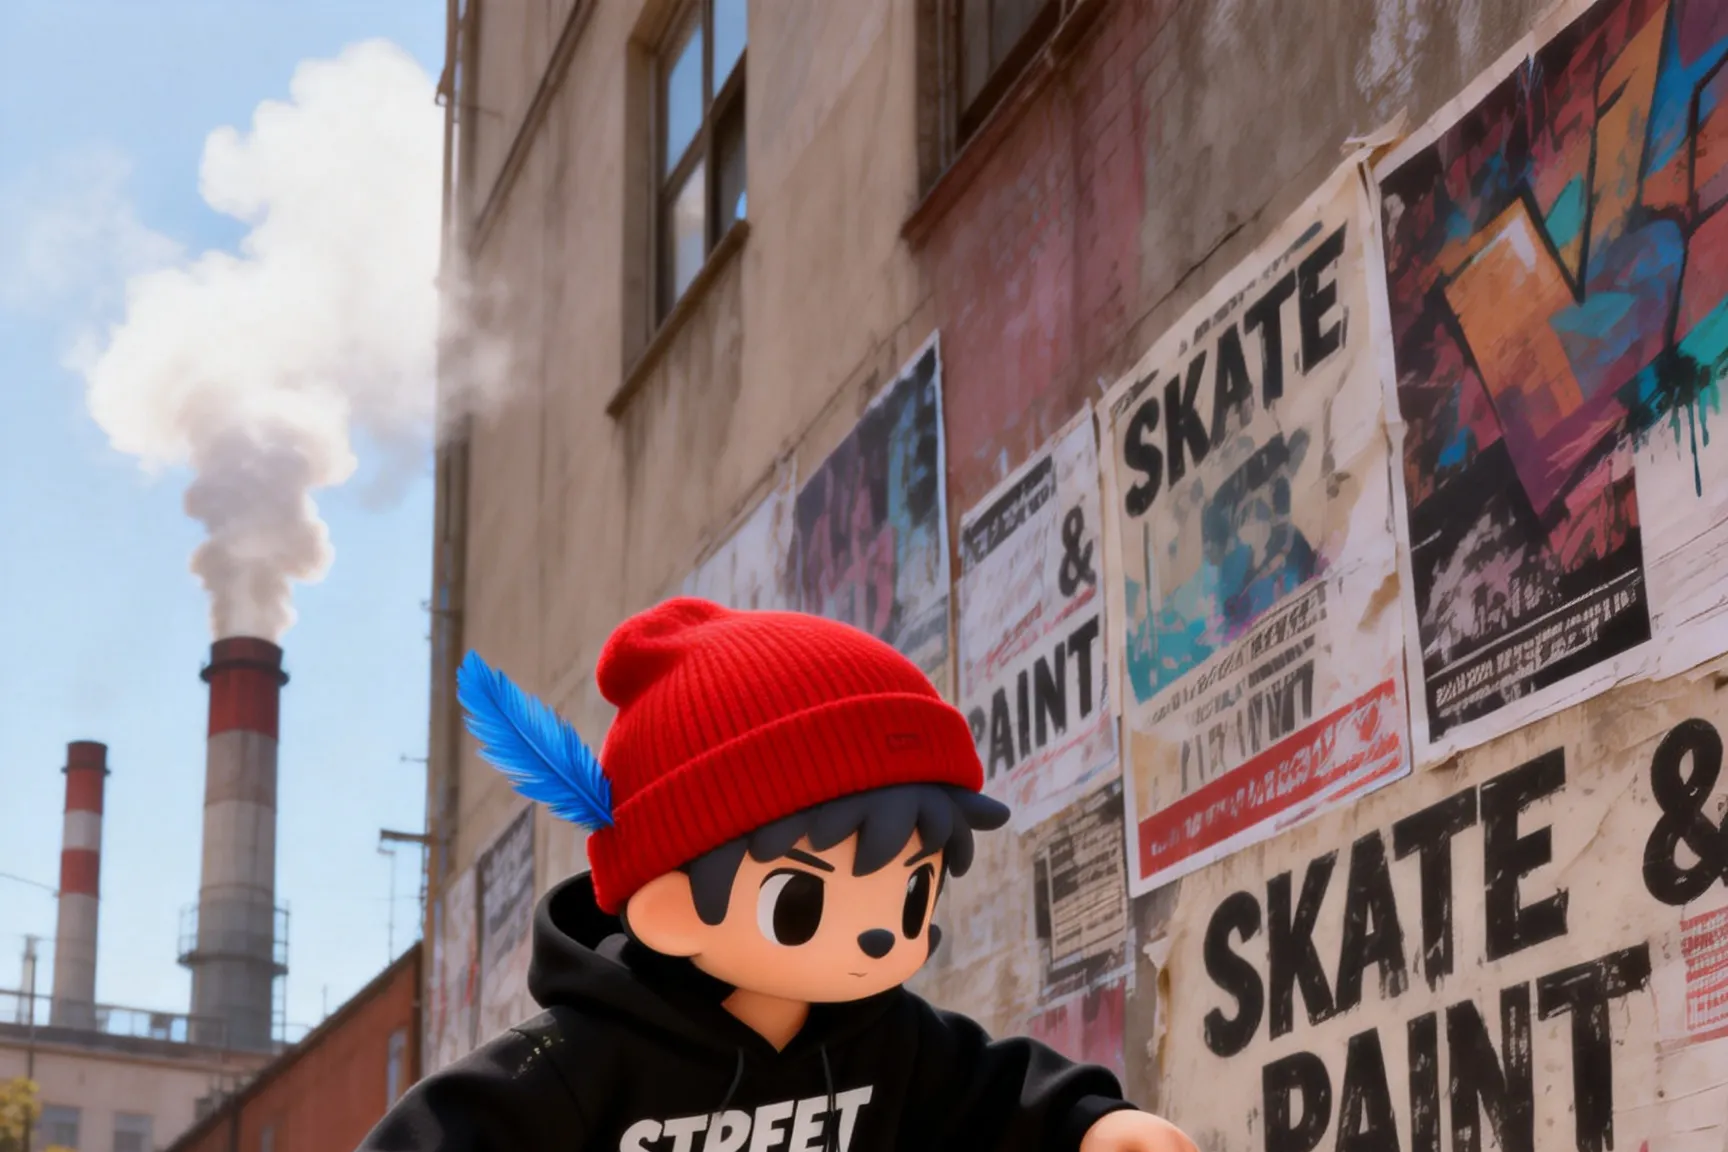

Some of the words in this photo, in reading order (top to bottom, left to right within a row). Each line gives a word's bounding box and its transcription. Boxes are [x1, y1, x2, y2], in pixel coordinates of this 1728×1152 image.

[1123, 221, 1347, 517] SKATE
[1059, 504, 1097, 598] &
[1203, 746, 1570, 1058] SKATE
[1643, 717, 1728, 906] &
